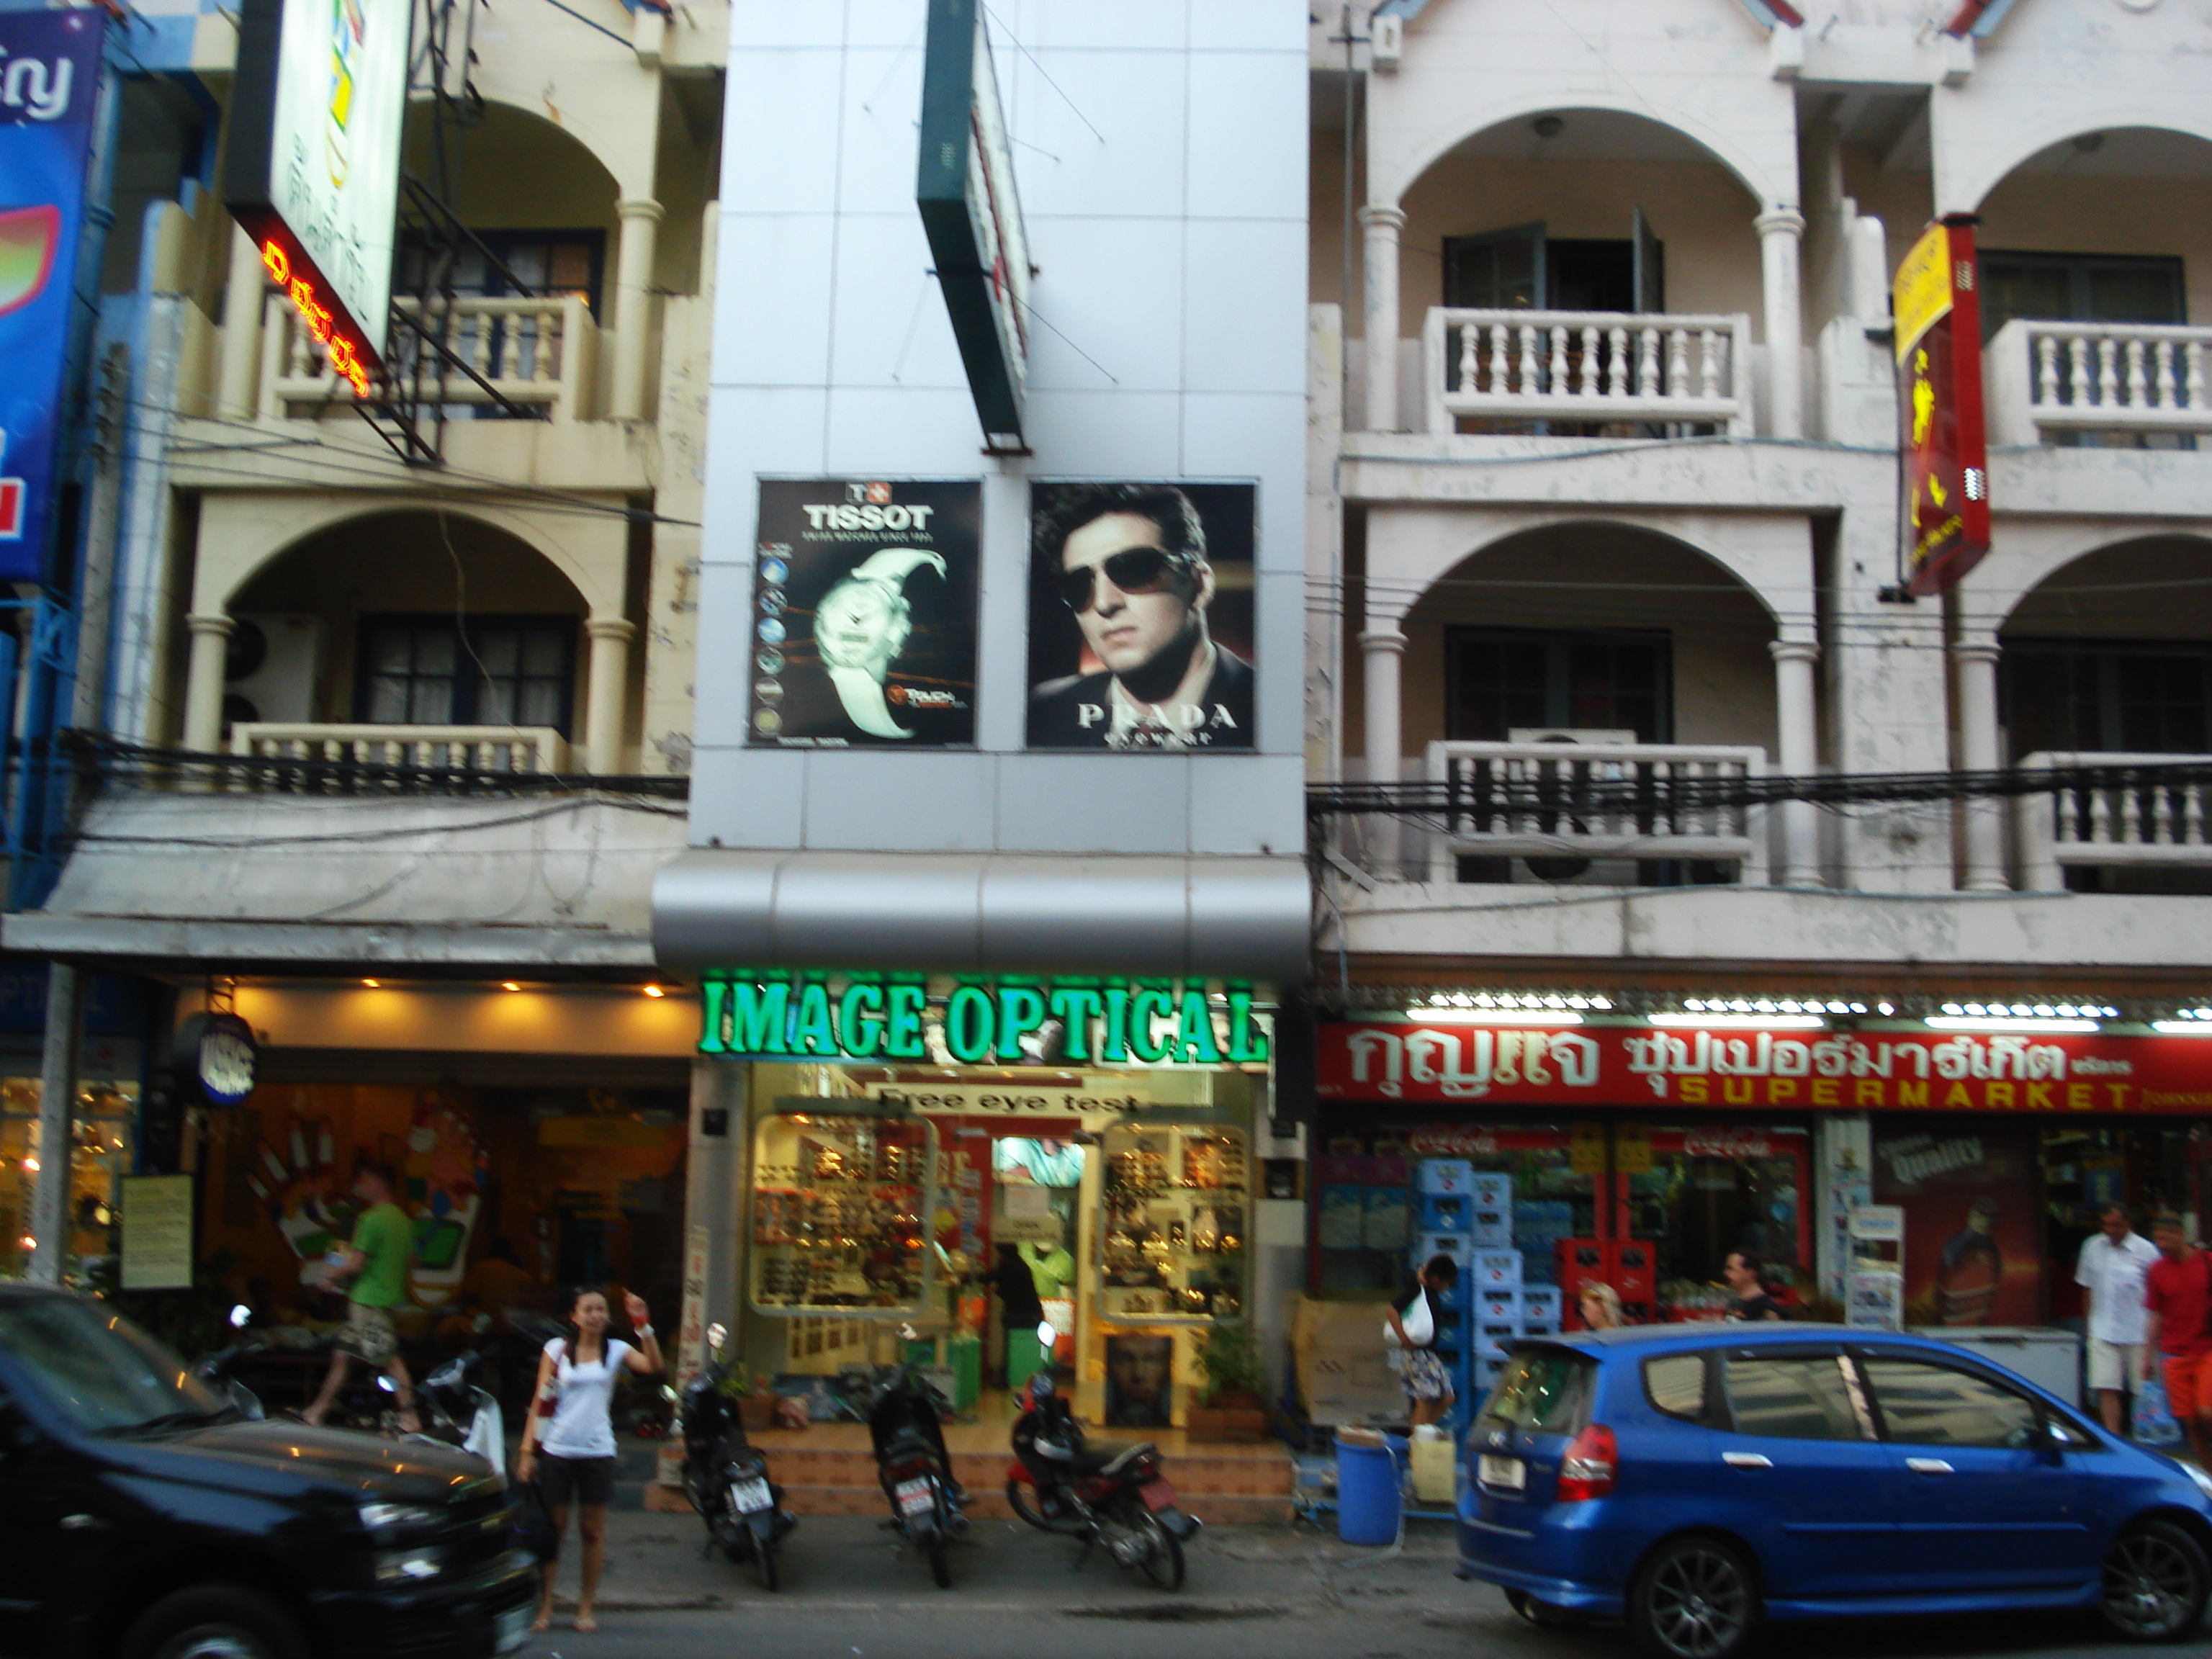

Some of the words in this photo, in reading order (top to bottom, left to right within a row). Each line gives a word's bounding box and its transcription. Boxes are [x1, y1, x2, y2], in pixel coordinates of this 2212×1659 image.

[802, 504, 934, 531] TISSOT
[1078, 703, 1238, 729] PRADA
[698, 980, 927, 1057] IMAGE
[945, 986, 1268, 1063] OPTICAL
[880, 1088, 967, 1110] Free
[977, 1094, 1048, 1113] eye
[1064, 1094, 1138, 1113] test
[1679, 1077, 2131, 1110] SUPERMARKET
